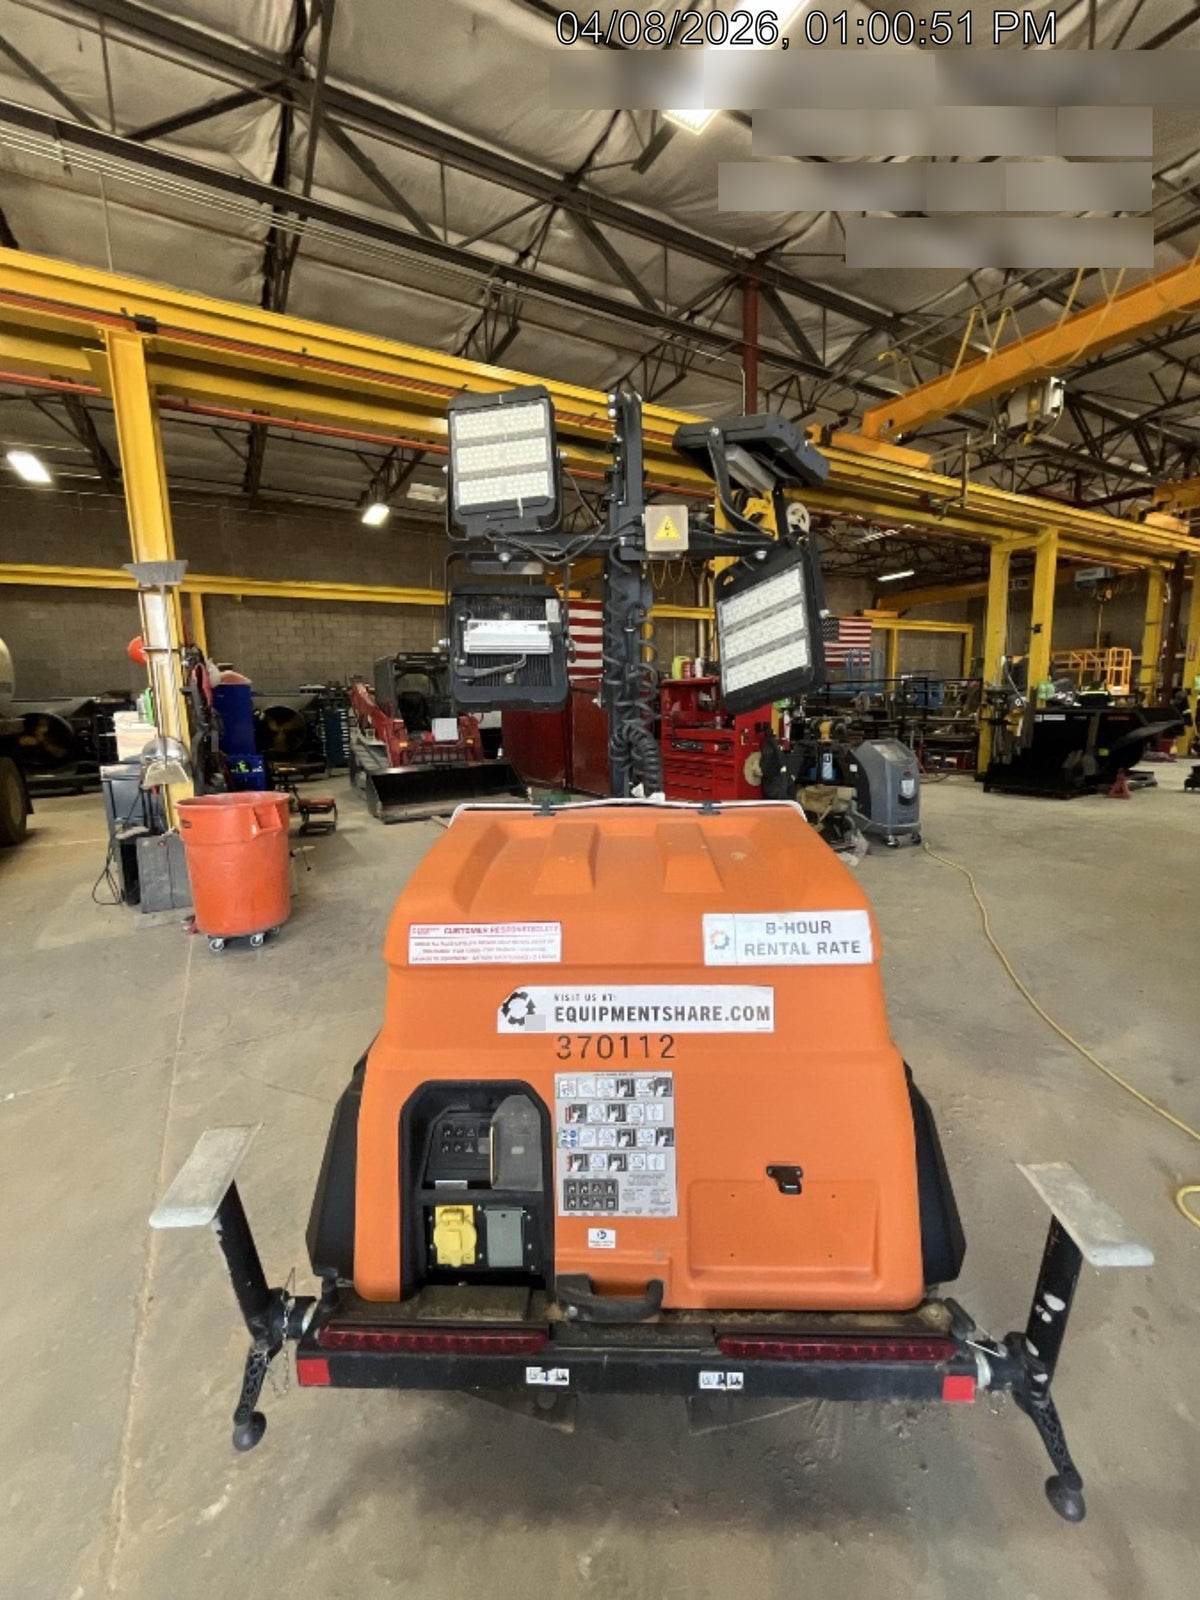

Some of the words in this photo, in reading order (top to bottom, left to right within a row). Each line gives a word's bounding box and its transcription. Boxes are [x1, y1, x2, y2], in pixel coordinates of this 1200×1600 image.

[744, 941, 811, 956] RENTAL
[817, 940, 861, 954] RATE
[585, 993, 597, 1001] US
[555, 1005, 770, 1023] EQUIPMENTSHARE.COM
[556, 1034, 676, 1060] 370112
